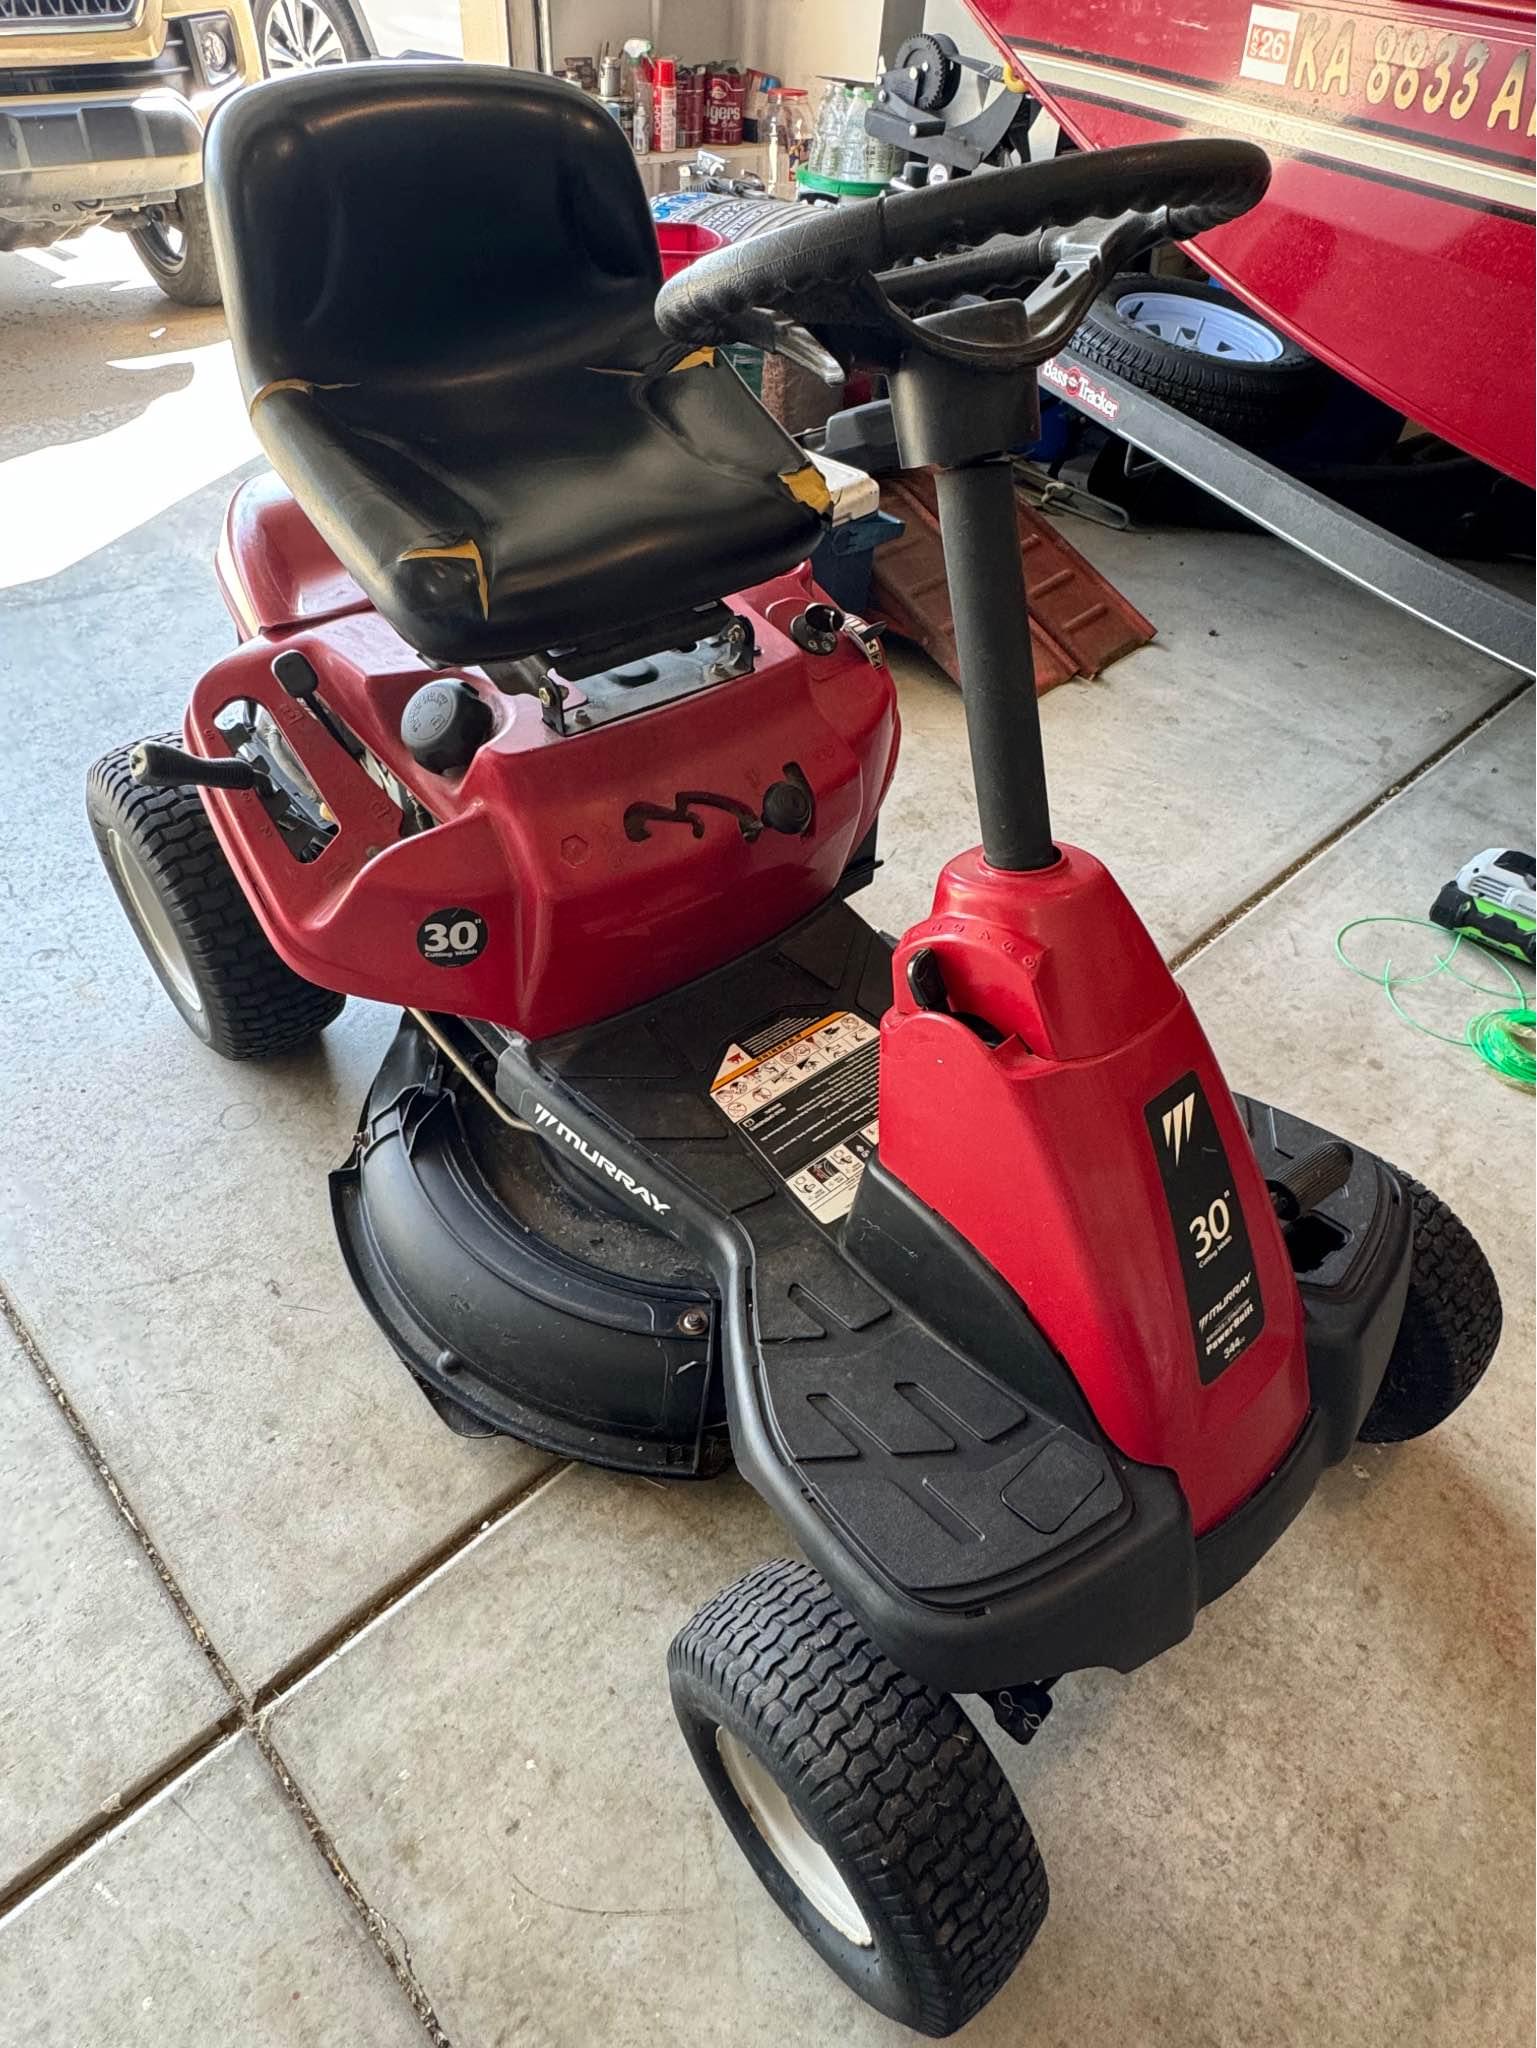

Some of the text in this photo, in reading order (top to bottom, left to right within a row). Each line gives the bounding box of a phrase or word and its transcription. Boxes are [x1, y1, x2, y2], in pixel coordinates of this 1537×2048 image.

[1259, 29, 1287, 62] 26
[1294, 12, 1536, 138] KA 8833 A
[703, 99, 741, 126] lgers
[1043, 359, 1118, 418] Bass Tracker
[424, 918, 482, 953] 30"
[555, 1121, 672, 1213] MURRAY
[1189, 1189, 1231, 1260] 30"
[1208, 1271, 1252, 1321] MURRAY
[1205, 1302, 1254, 1356] PowerBuilt
